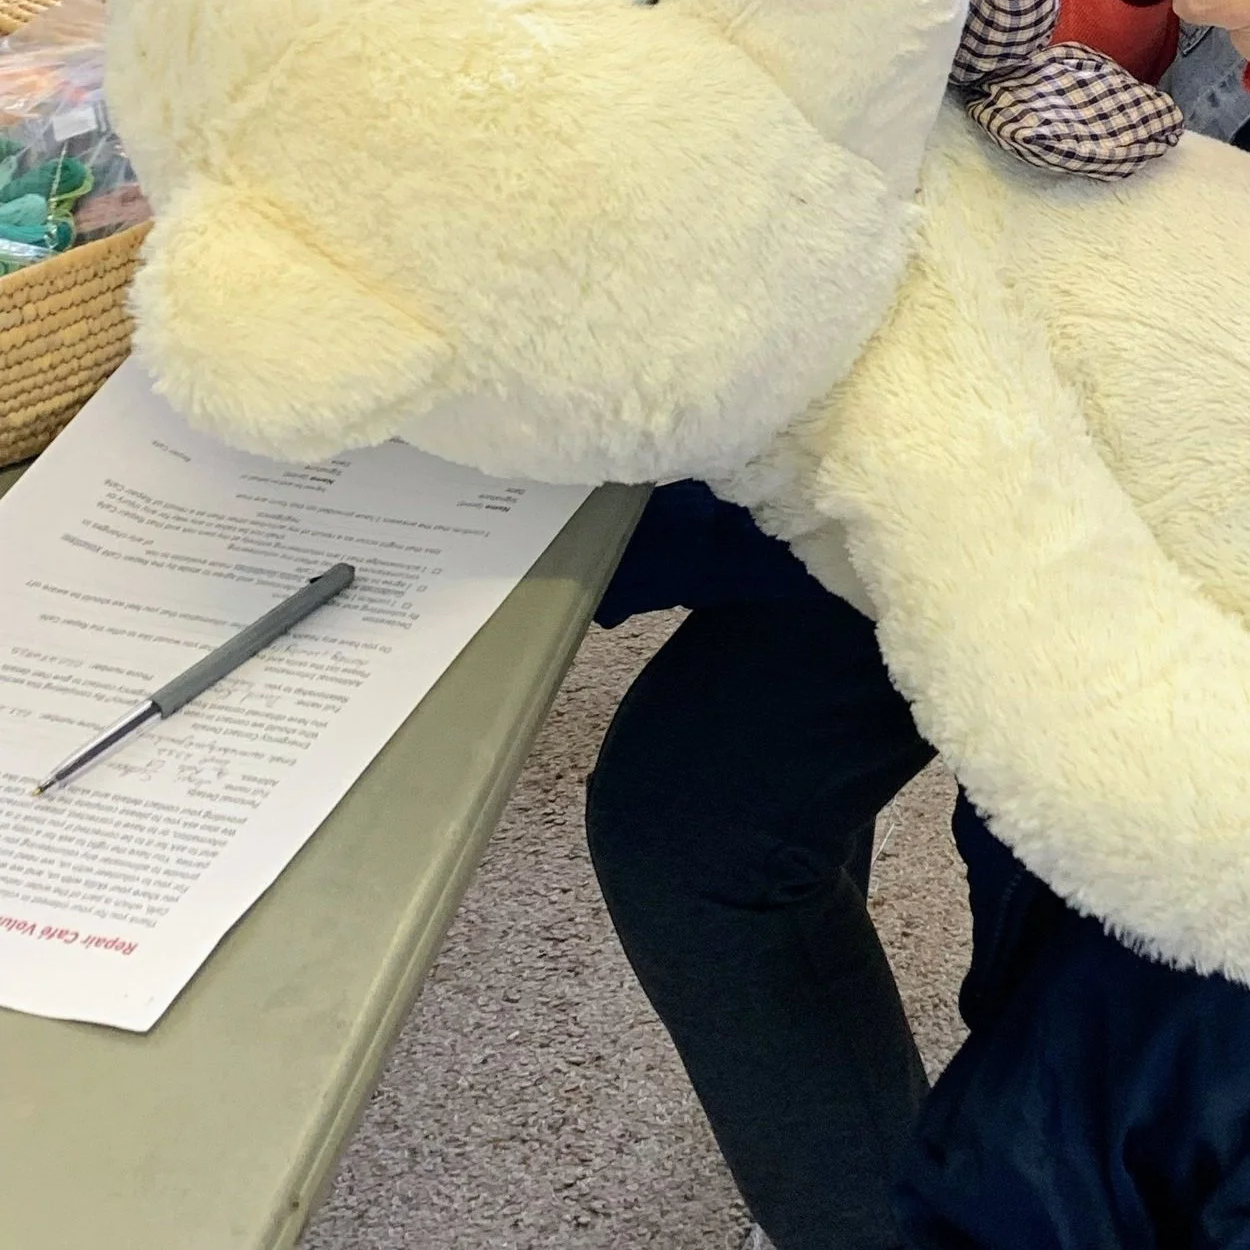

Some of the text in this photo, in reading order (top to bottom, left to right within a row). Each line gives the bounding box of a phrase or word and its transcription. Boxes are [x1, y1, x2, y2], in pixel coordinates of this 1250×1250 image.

[0, 916, 139, 956] Repair Café Volu
